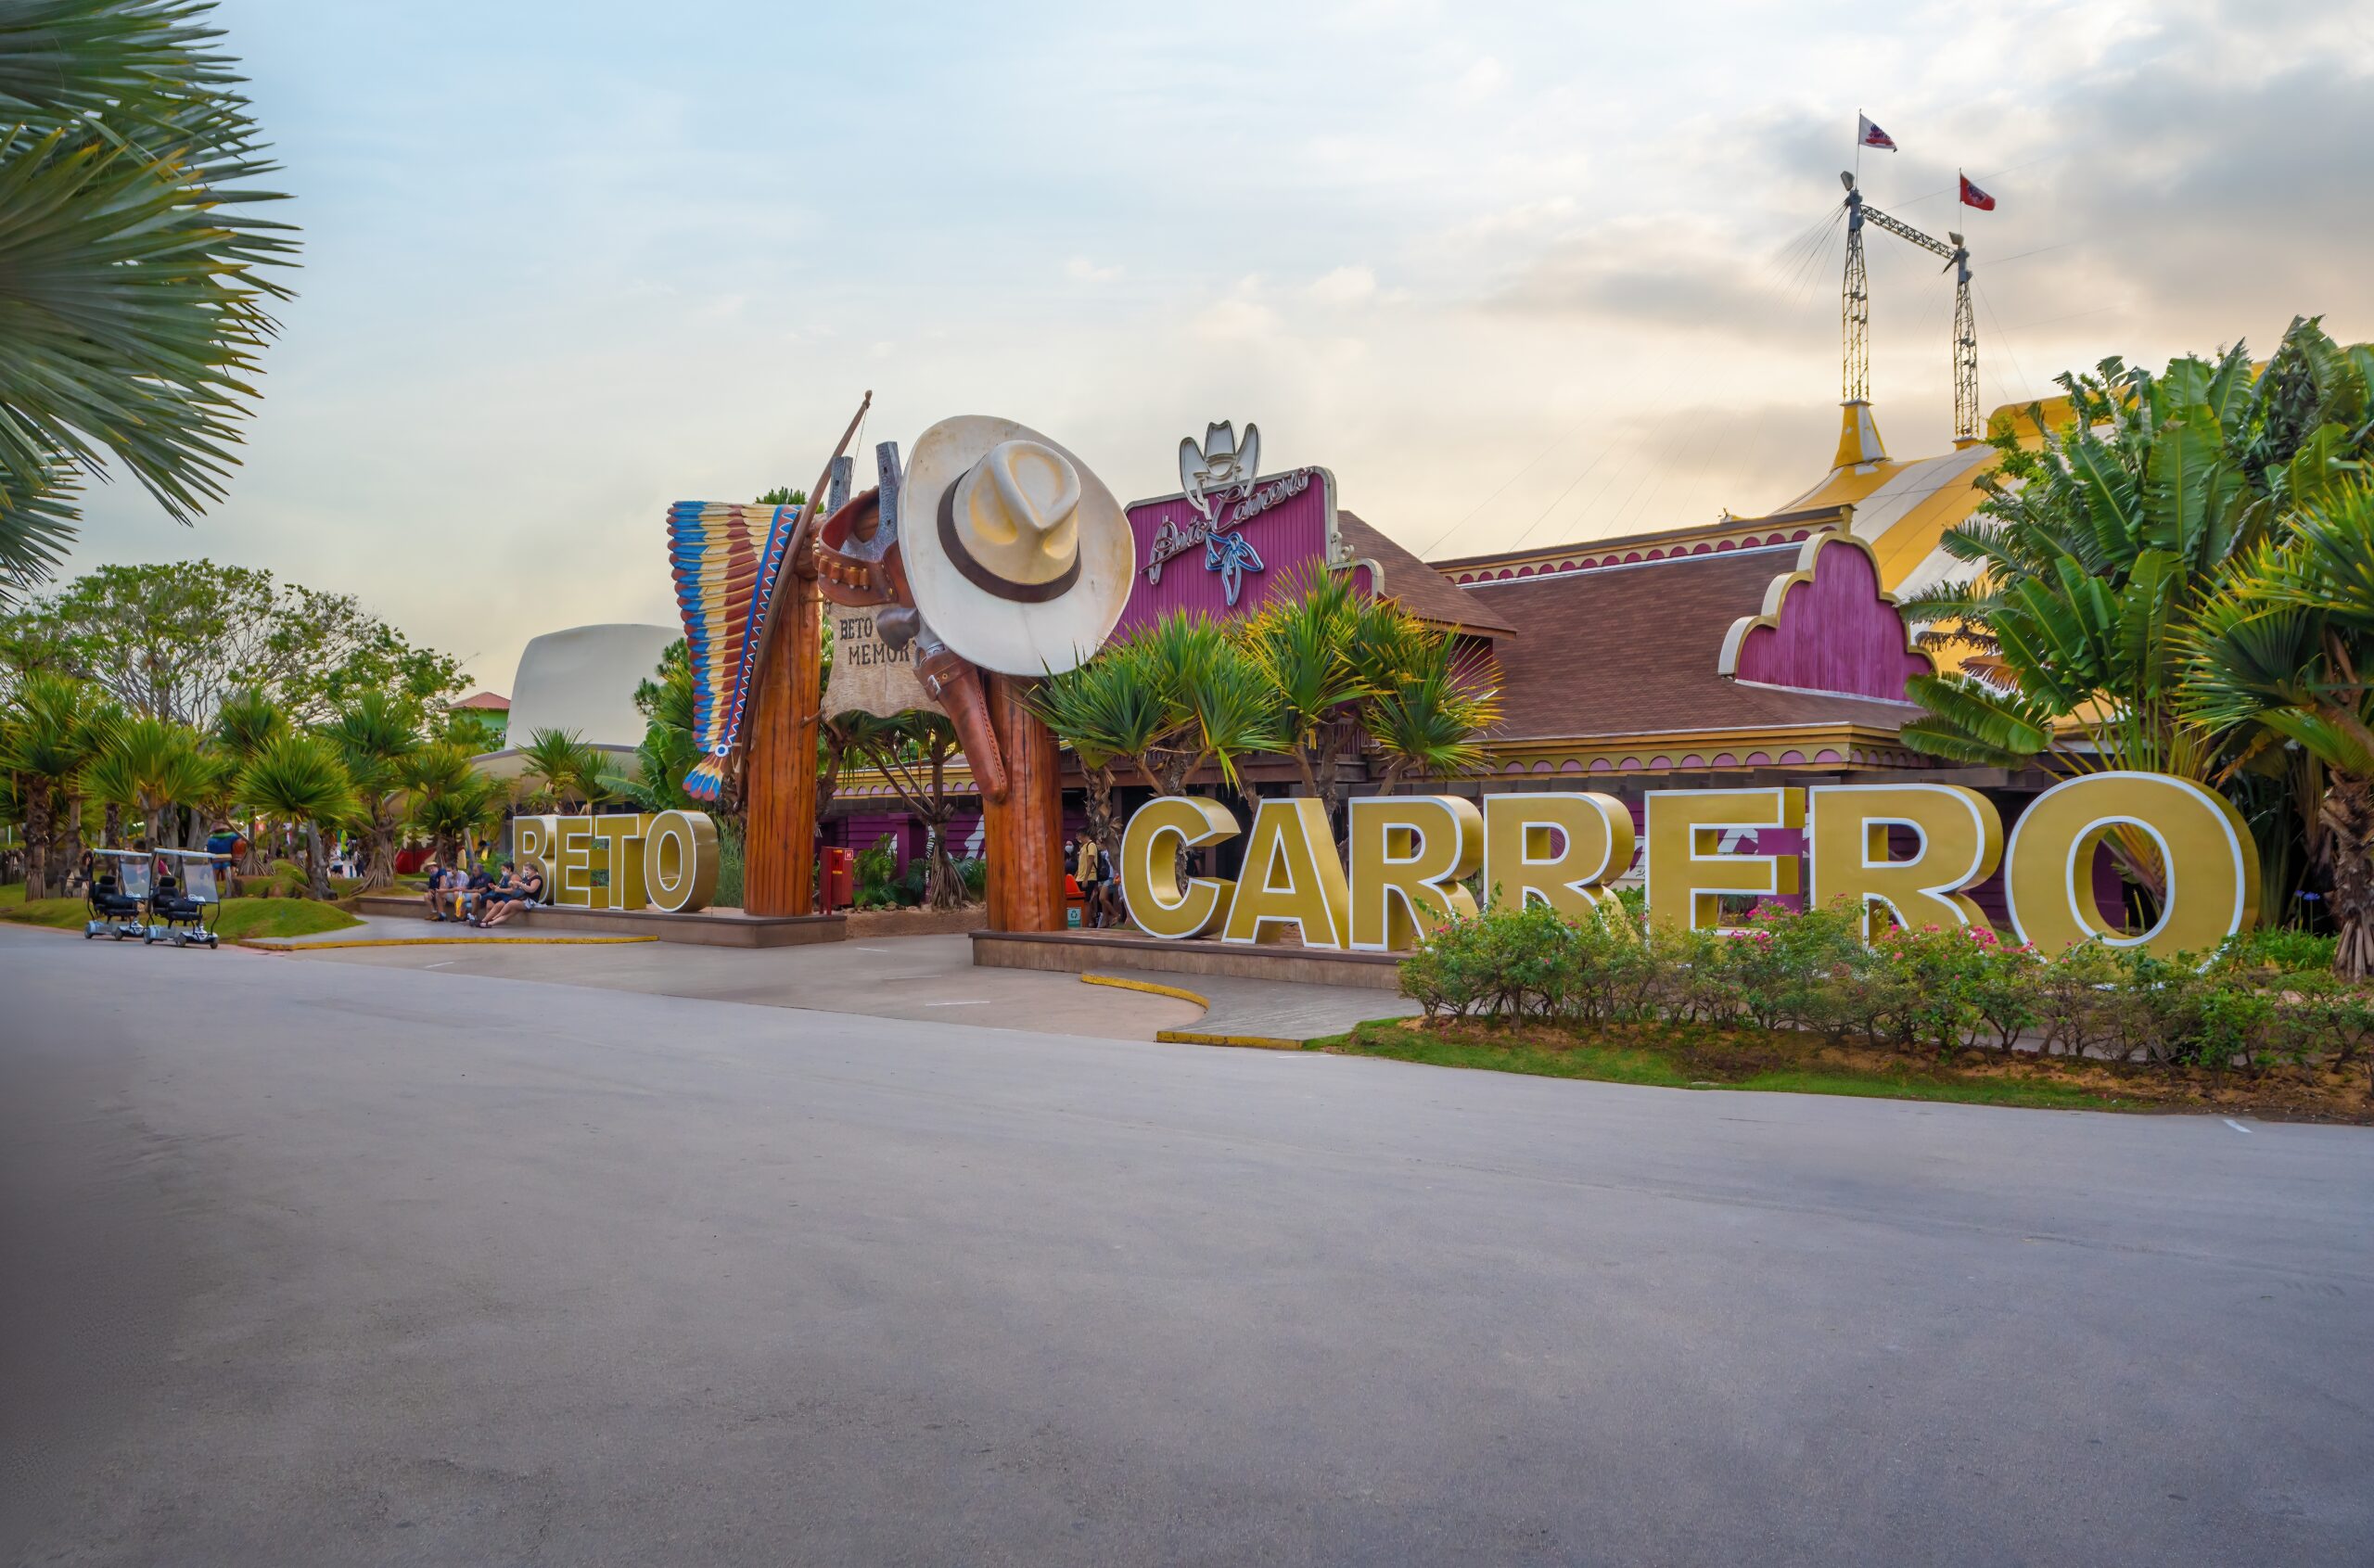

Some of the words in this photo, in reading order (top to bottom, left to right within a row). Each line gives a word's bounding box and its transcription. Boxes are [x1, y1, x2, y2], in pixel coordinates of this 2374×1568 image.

[839, 617, 874, 641] BETO
[848, 640, 916, 666] MEMOR
[513, 809, 720, 913] BETO
[1120, 771, 2261, 981] CARRERO
